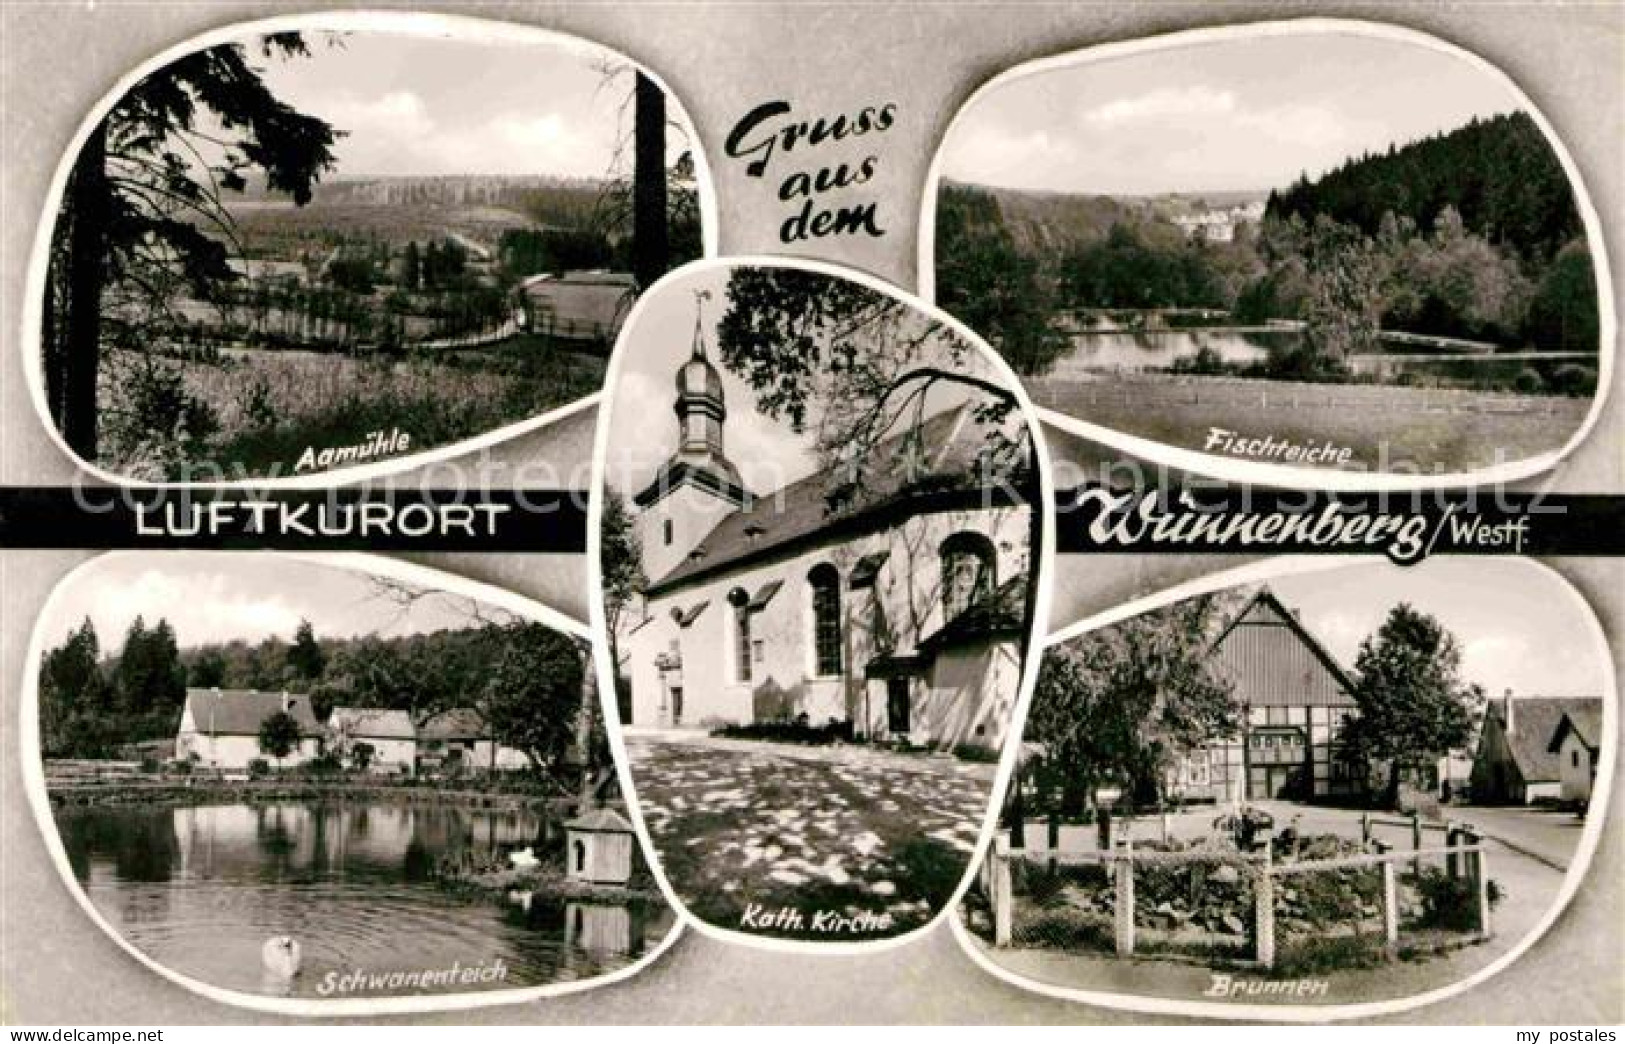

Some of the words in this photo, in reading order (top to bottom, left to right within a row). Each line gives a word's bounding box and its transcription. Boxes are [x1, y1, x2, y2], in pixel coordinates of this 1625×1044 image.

[724, 101, 897, 177] Gruss
[778, 155, 878, 202] aus
[779, 198, 886, 243] dem
[294, 427, 411, 471] Aamühle
[1204, 426, 1353, 464] Fischteiche
[135, 502, 511, 537] LUFTKURORT
[740, 902, 804, 931] Kath.
[810, 909, 894, 934] Kirche
[316, 959, 508, 996] Schwanenteich
[1203, 974, 1330, 998] Brunnen
